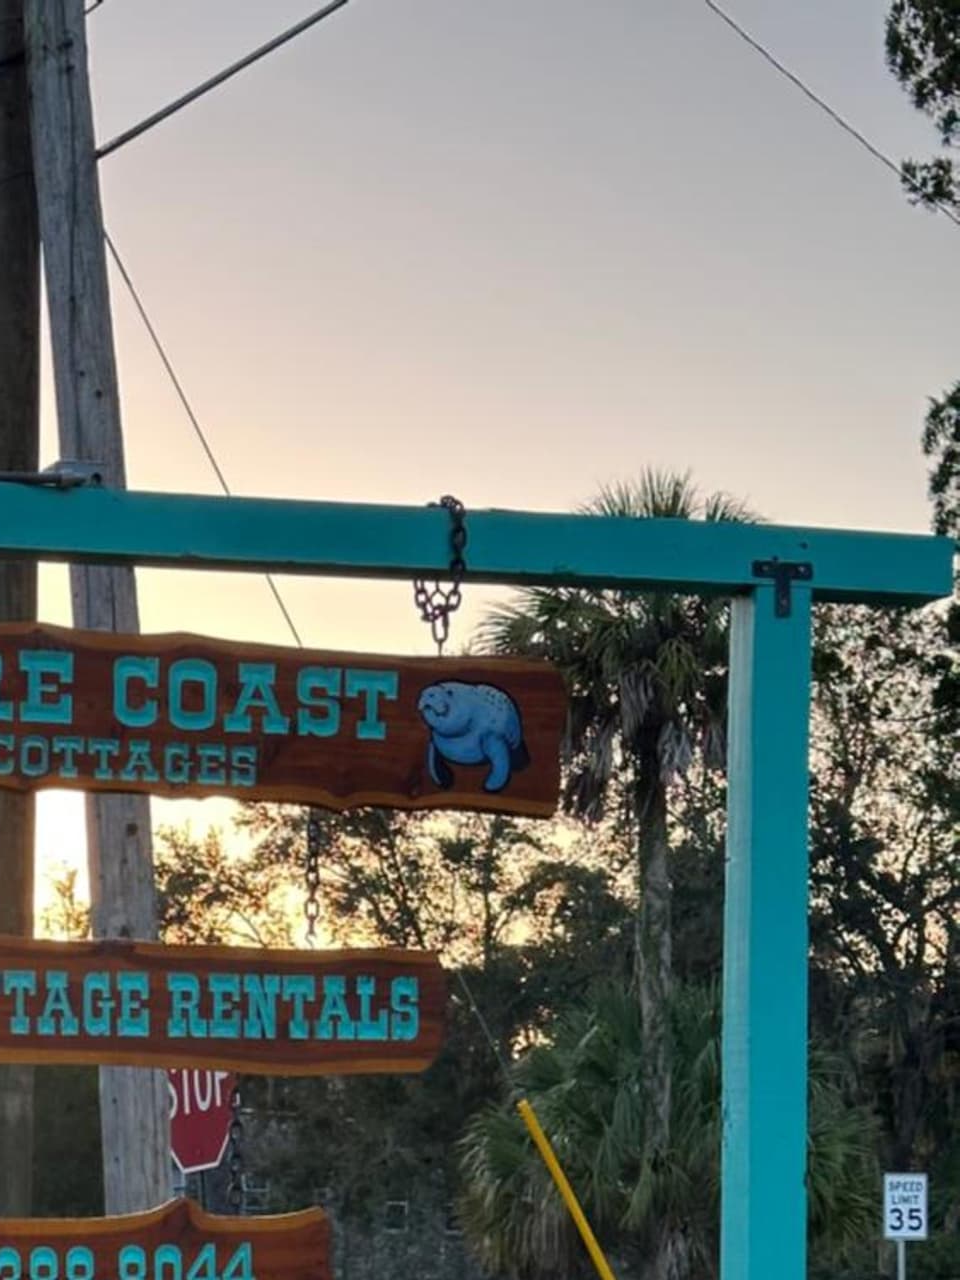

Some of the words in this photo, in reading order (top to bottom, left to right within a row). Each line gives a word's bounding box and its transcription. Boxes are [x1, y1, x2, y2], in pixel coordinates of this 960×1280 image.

[112, 656, 399, 740] COAST
[166, 971, 420, 1041] RENTALS
[888, 1181, 923, 1192] SPEED
[891, 1194, 920, 1205] LIMIT
[889, 1208, 923, 1231] 35
